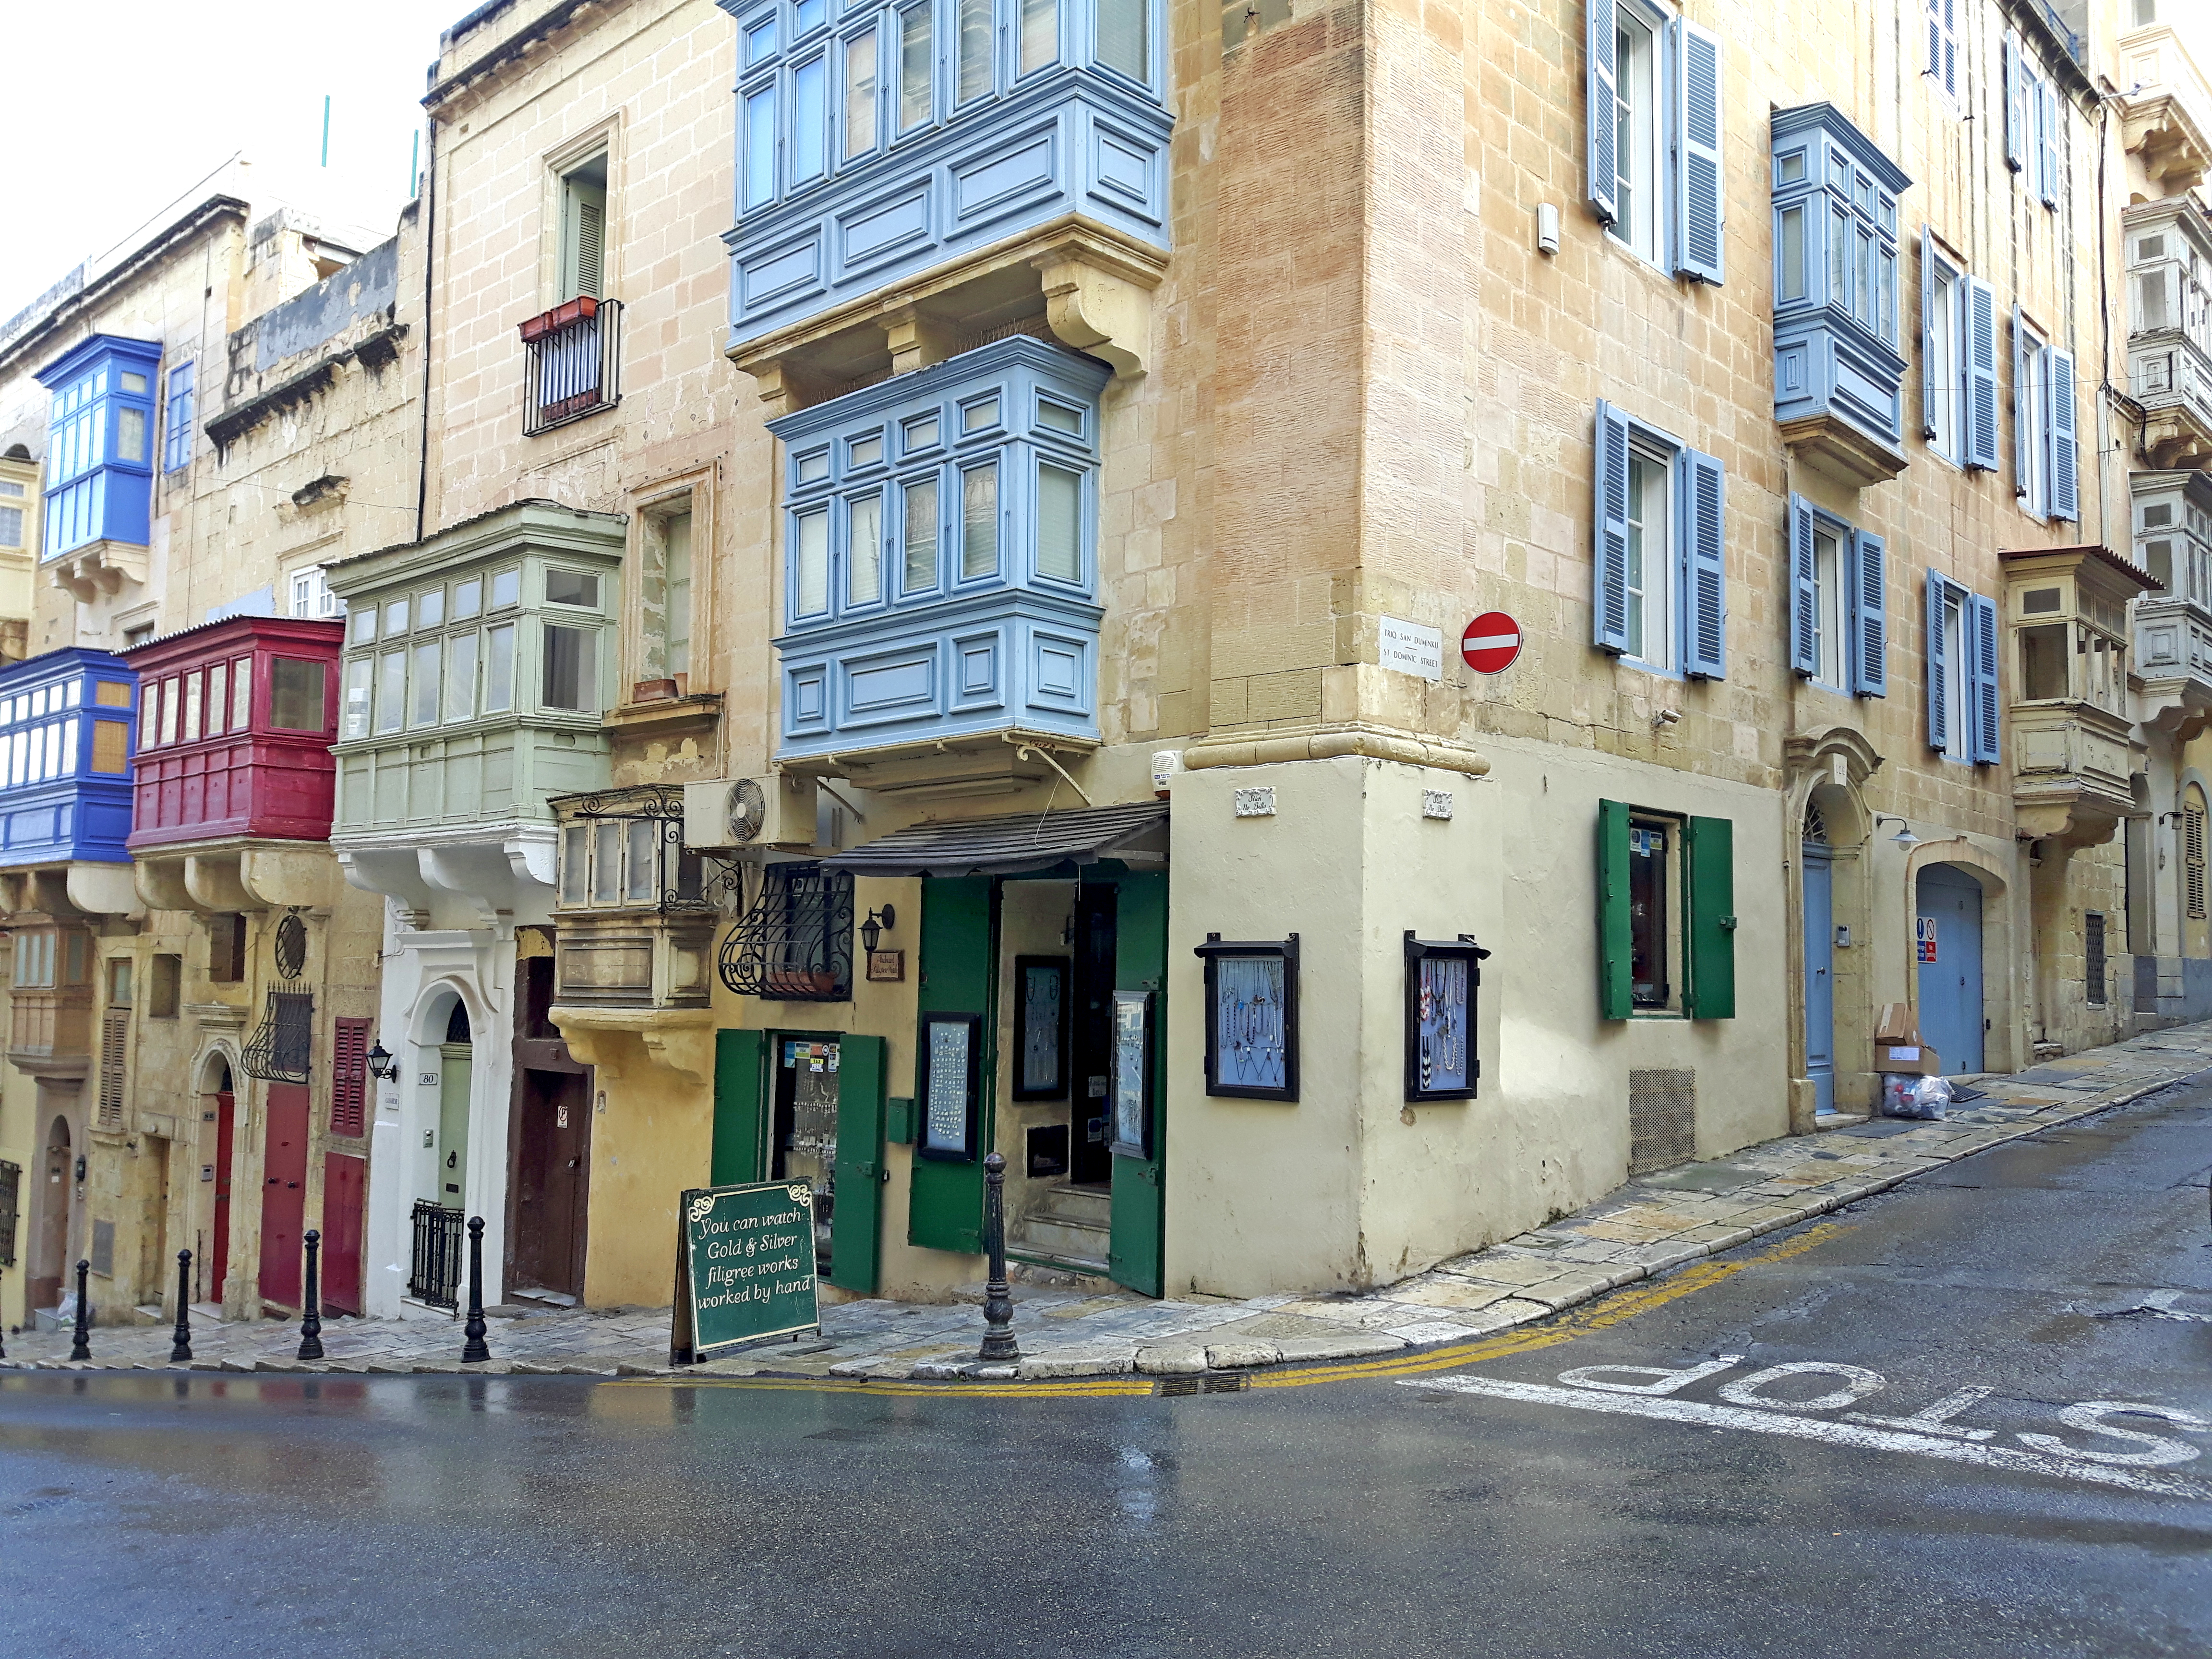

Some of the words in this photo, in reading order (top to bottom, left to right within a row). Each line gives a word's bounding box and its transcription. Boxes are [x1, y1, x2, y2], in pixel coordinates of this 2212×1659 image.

[1384, 629, 1397, 640] TRIQ
[1400, 633, 1411, 642] SAN
[1414, 637, 1439, 649] DUMINKU
[1394, 650, 1417, 663] DOMINIC
[1420, 657, 1438, 668] STREET
[1253, 802, 1266, 810] Bills
[698, 1217, 729, 1240] You
[733, 1217, 758, 1232] can
[761, 1207, 802, 1227] watch
[708, 1238, 742, 1260] Gold
[745, 1236, 757, 1257] &
[759, 1233, 798, 1252] Silver
[705, 1266, 755, 1290] filigree
[758, 1255, 799, 1275] works
[698, 1285, 750, 1310] worked
[754, 1285, 770, 1303] by
[775, 1278, 811, 1295] hand
